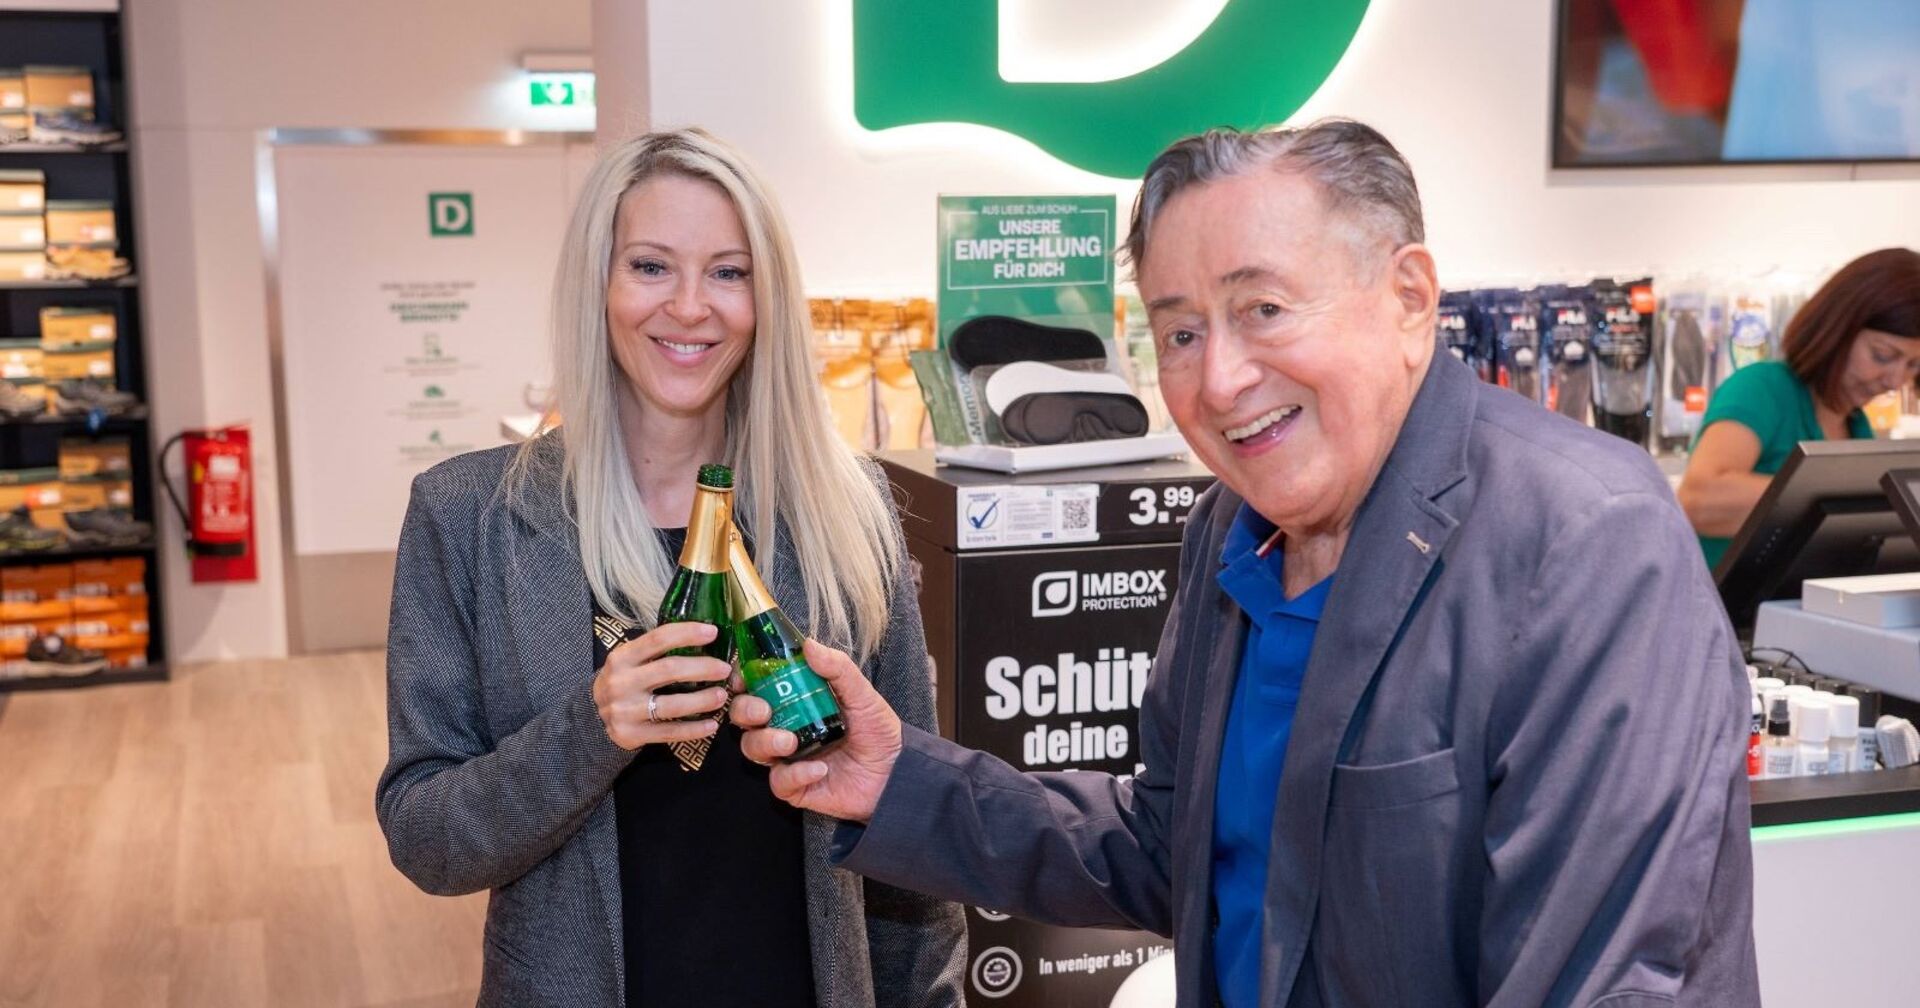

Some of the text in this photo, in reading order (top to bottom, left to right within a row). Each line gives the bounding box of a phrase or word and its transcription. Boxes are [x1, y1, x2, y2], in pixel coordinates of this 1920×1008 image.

[436, 199, 469, 230] D
[999, 219, 1061, 236] UNSERE
[955, 236, 1101, 260] EMPFEHLUNG
[993, 260, 1065, 279] FÜR DICH
[1082, 569, 1167, 597] IMBOX
[775, 681, 793, 697] D
[985, 647, 1157, 720] Schüt
[1023, 721, 1129, 766] deine
[1039, 957, 1053, 975] In
[1056, 953, 1110, 974] weniger
[1112, 950, 1133, 967] als
[1136, 947, 1143, 965] 1
